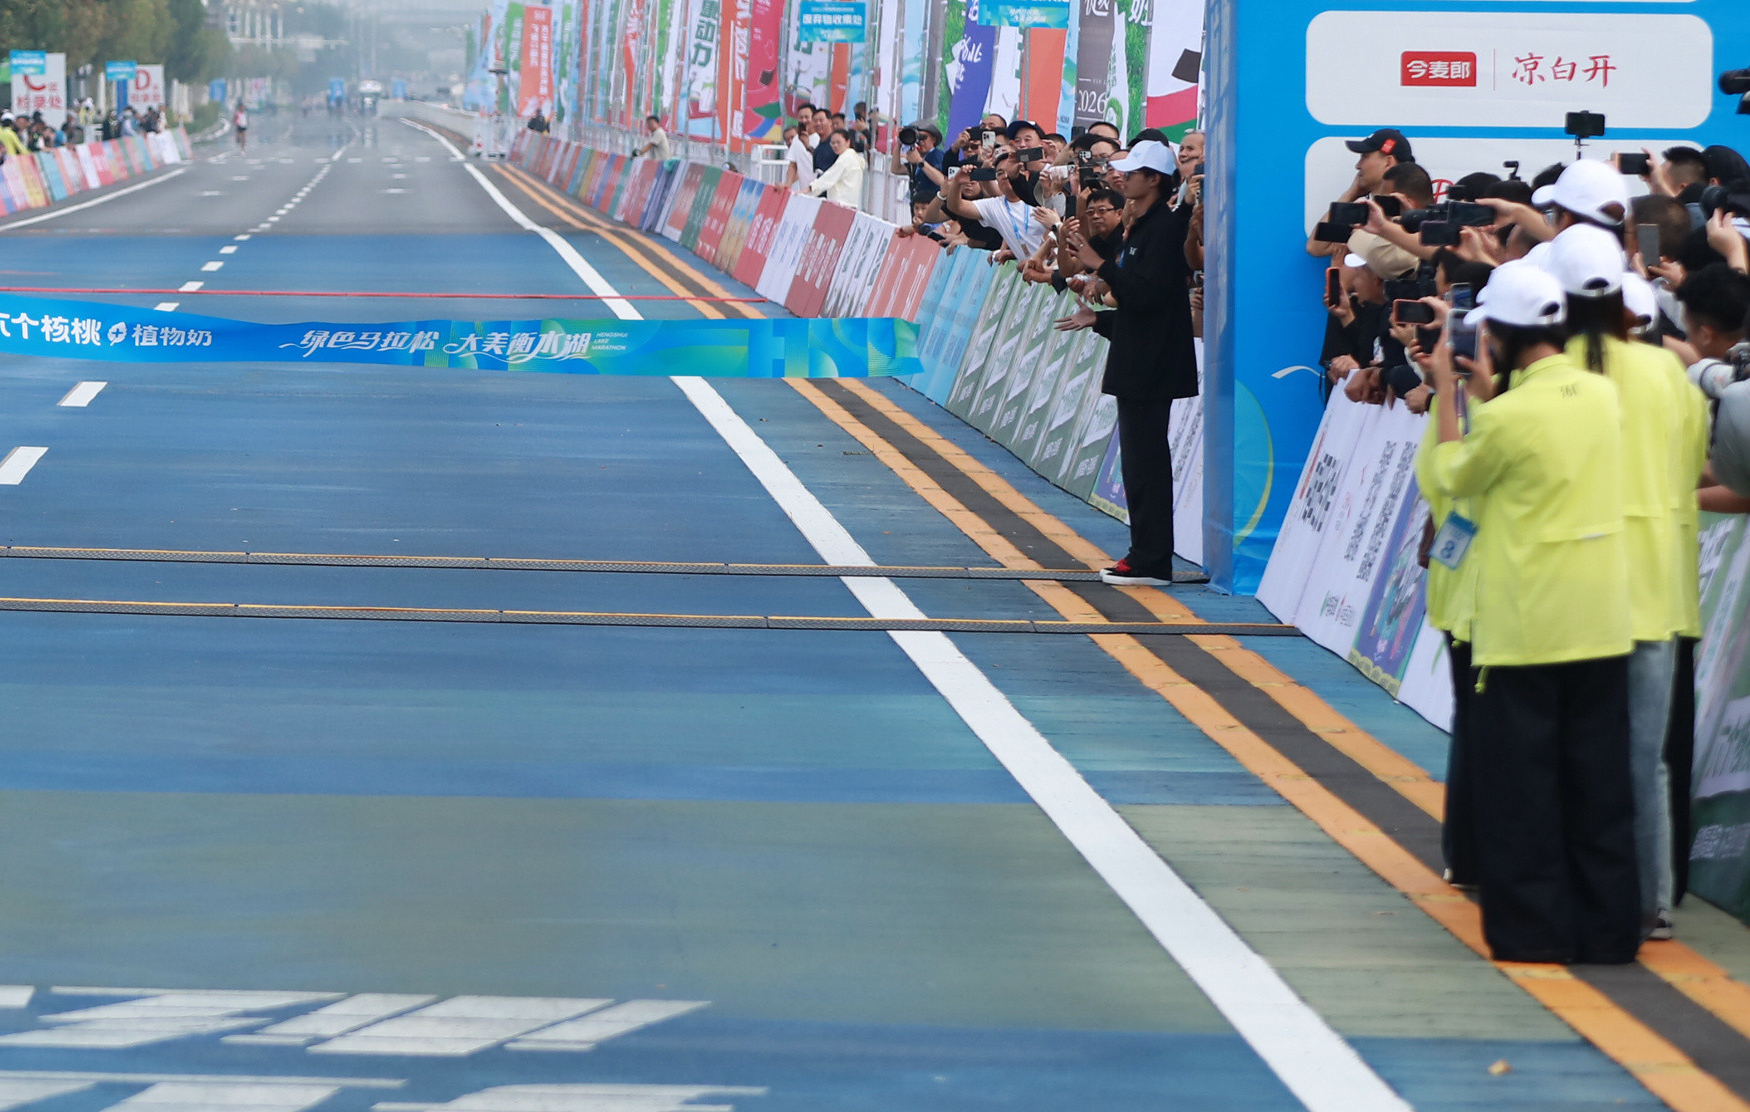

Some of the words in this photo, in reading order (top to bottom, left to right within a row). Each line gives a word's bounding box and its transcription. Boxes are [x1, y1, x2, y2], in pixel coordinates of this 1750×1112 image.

[1406, 60, 1471, 80] 今麦郎
[1512, 52, 1617, 88] 凉白开
[132, 322, 212, 348] 植物奶
[279, 330, 440, 358] 绿色马拉松
[443, 330, 592, 363] 大美衡水湖
